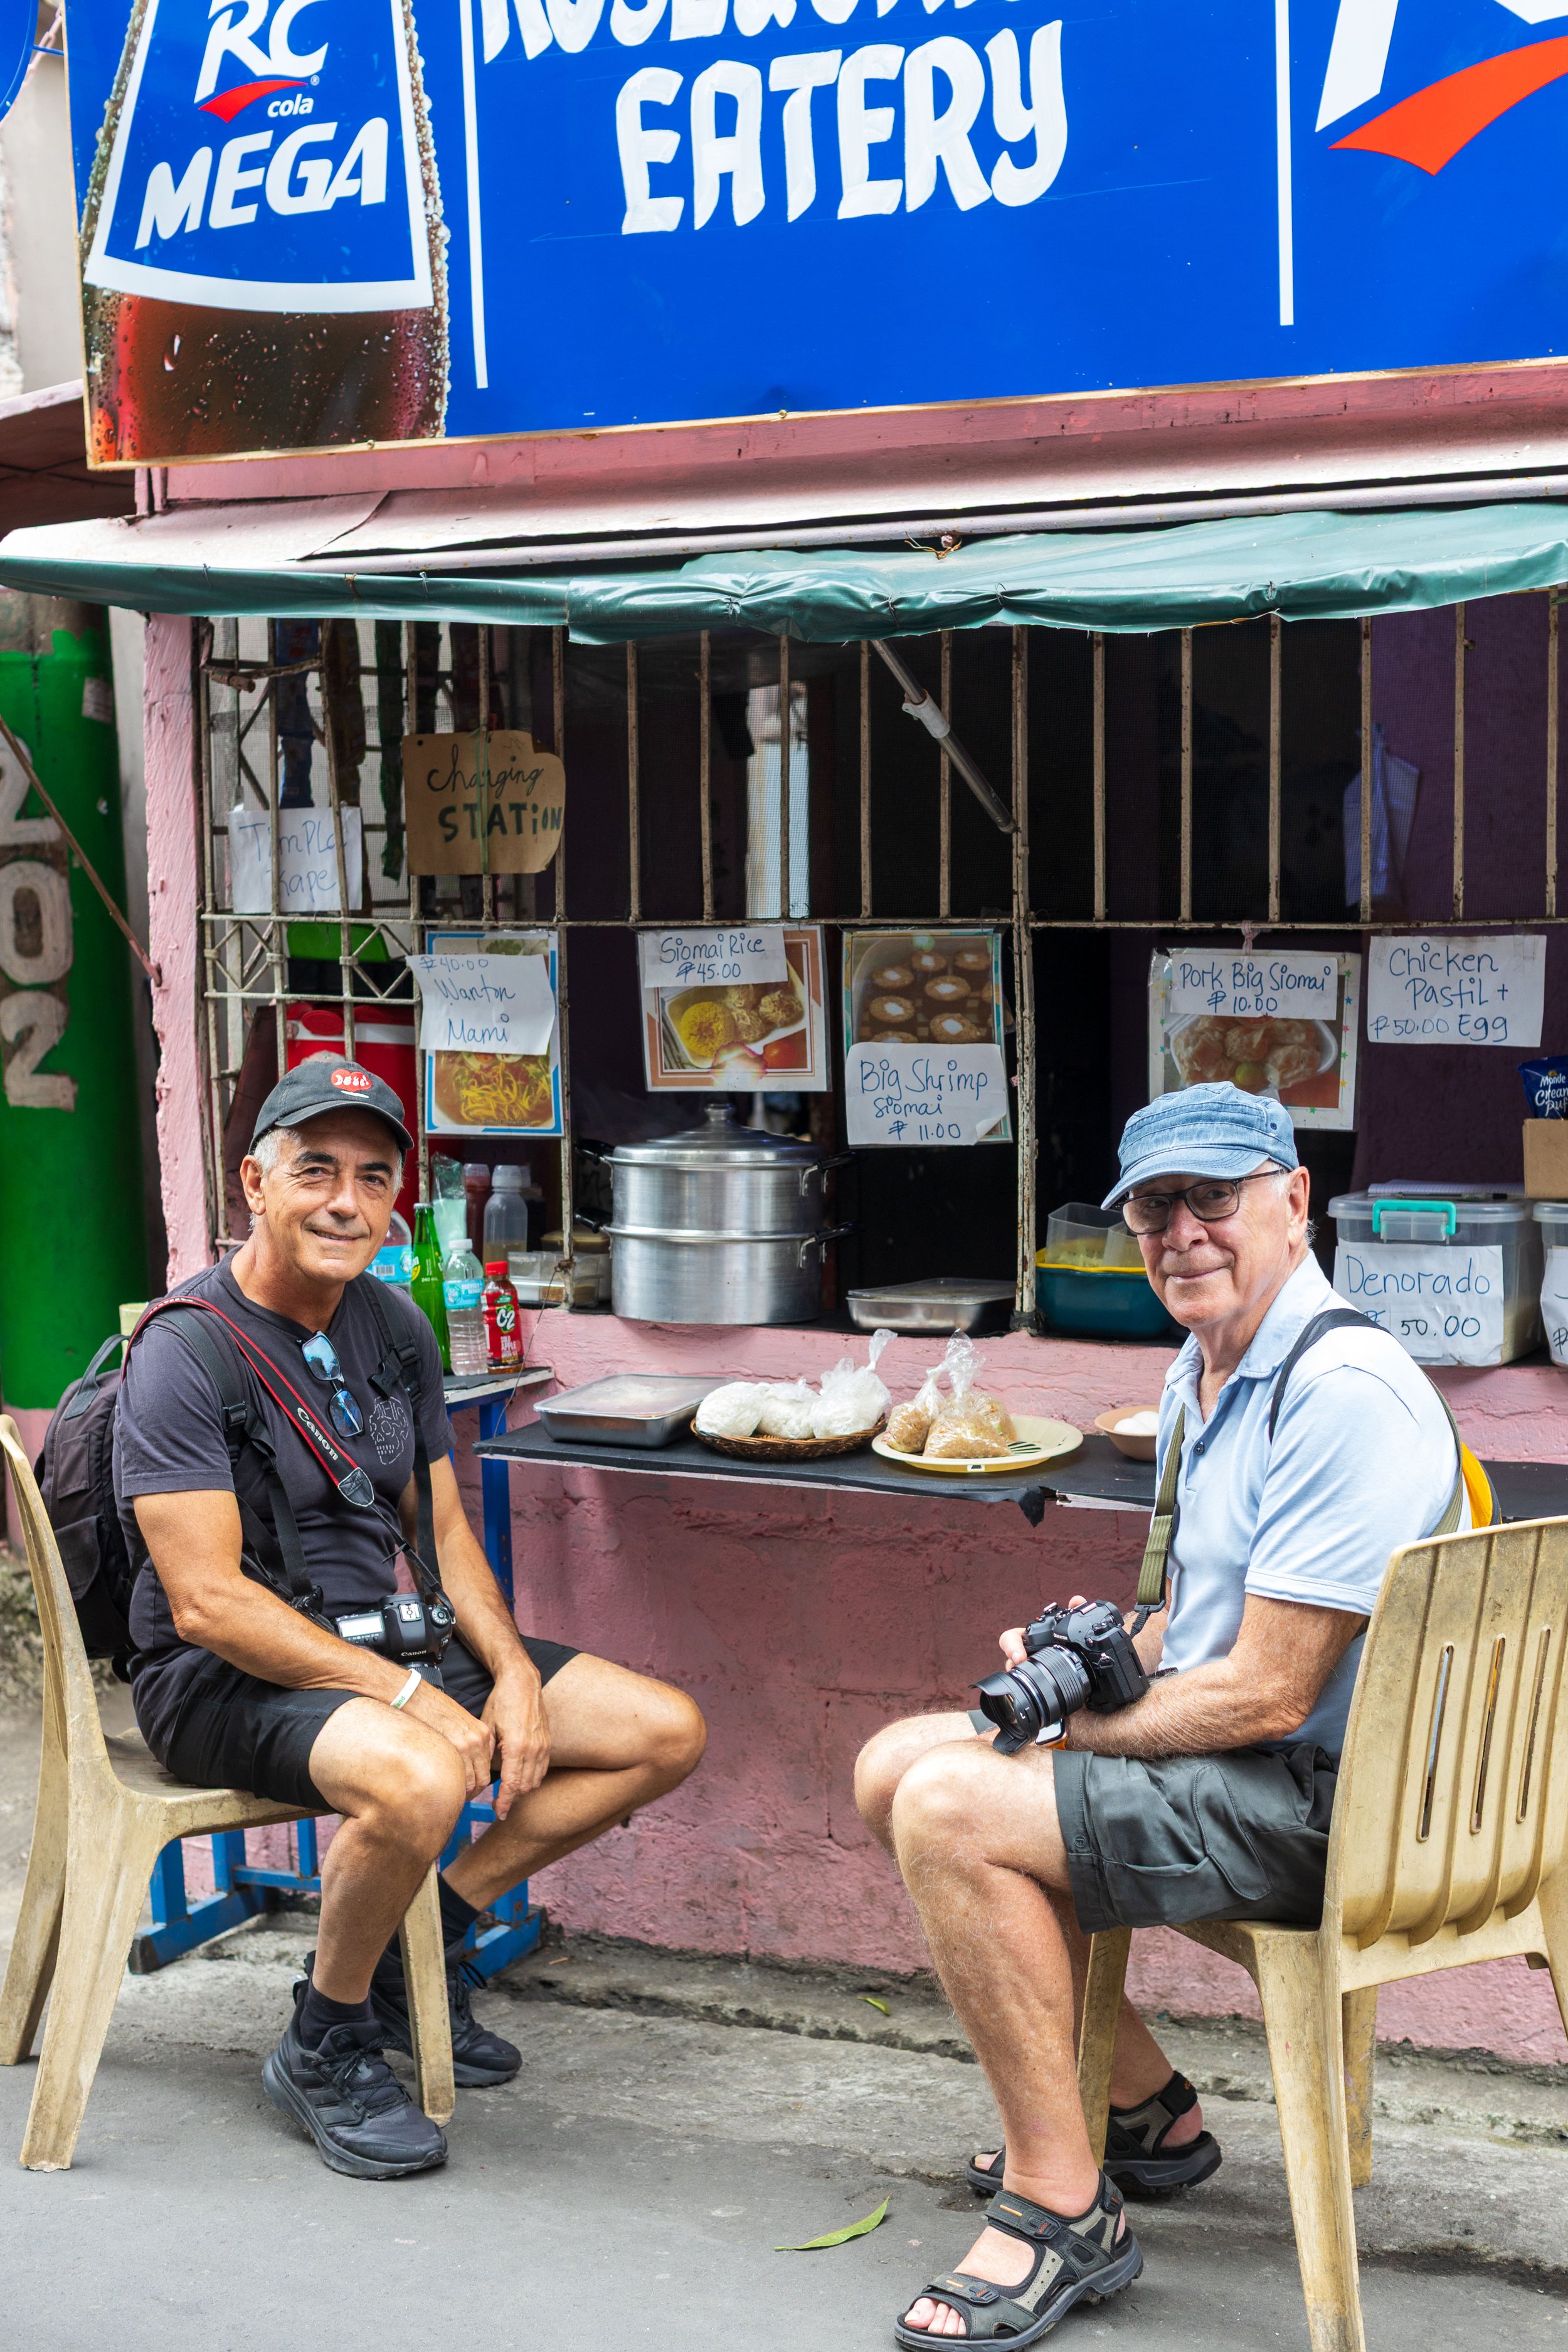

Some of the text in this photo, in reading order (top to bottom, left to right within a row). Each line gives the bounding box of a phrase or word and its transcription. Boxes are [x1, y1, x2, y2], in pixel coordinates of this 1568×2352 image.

[194, 0, 329, 104] RC
[267, 93, 314, 118] cola
[616, 20, 1067, 235] EATERY
[134, 117, 389, 250] MEGA
[659, 932, 765, 963] Siomai Rice
[1389, 942, 1499, 977] Chicken
[1180, 961, 1332, 997] Pork Big Siomai
[448, 1013, 510, 1046] Mami
[1458, 1013, 1508, 1042] Egg
[860, 1059, 988, 1101] Big Shrimp
[1540, 1073, 1566, 1088] Monde
[1346, 1254, 1491, 1296] Denorado
[496, 1308, 516, 1330] C2
[297, 1407, 339, 1461] Canon
